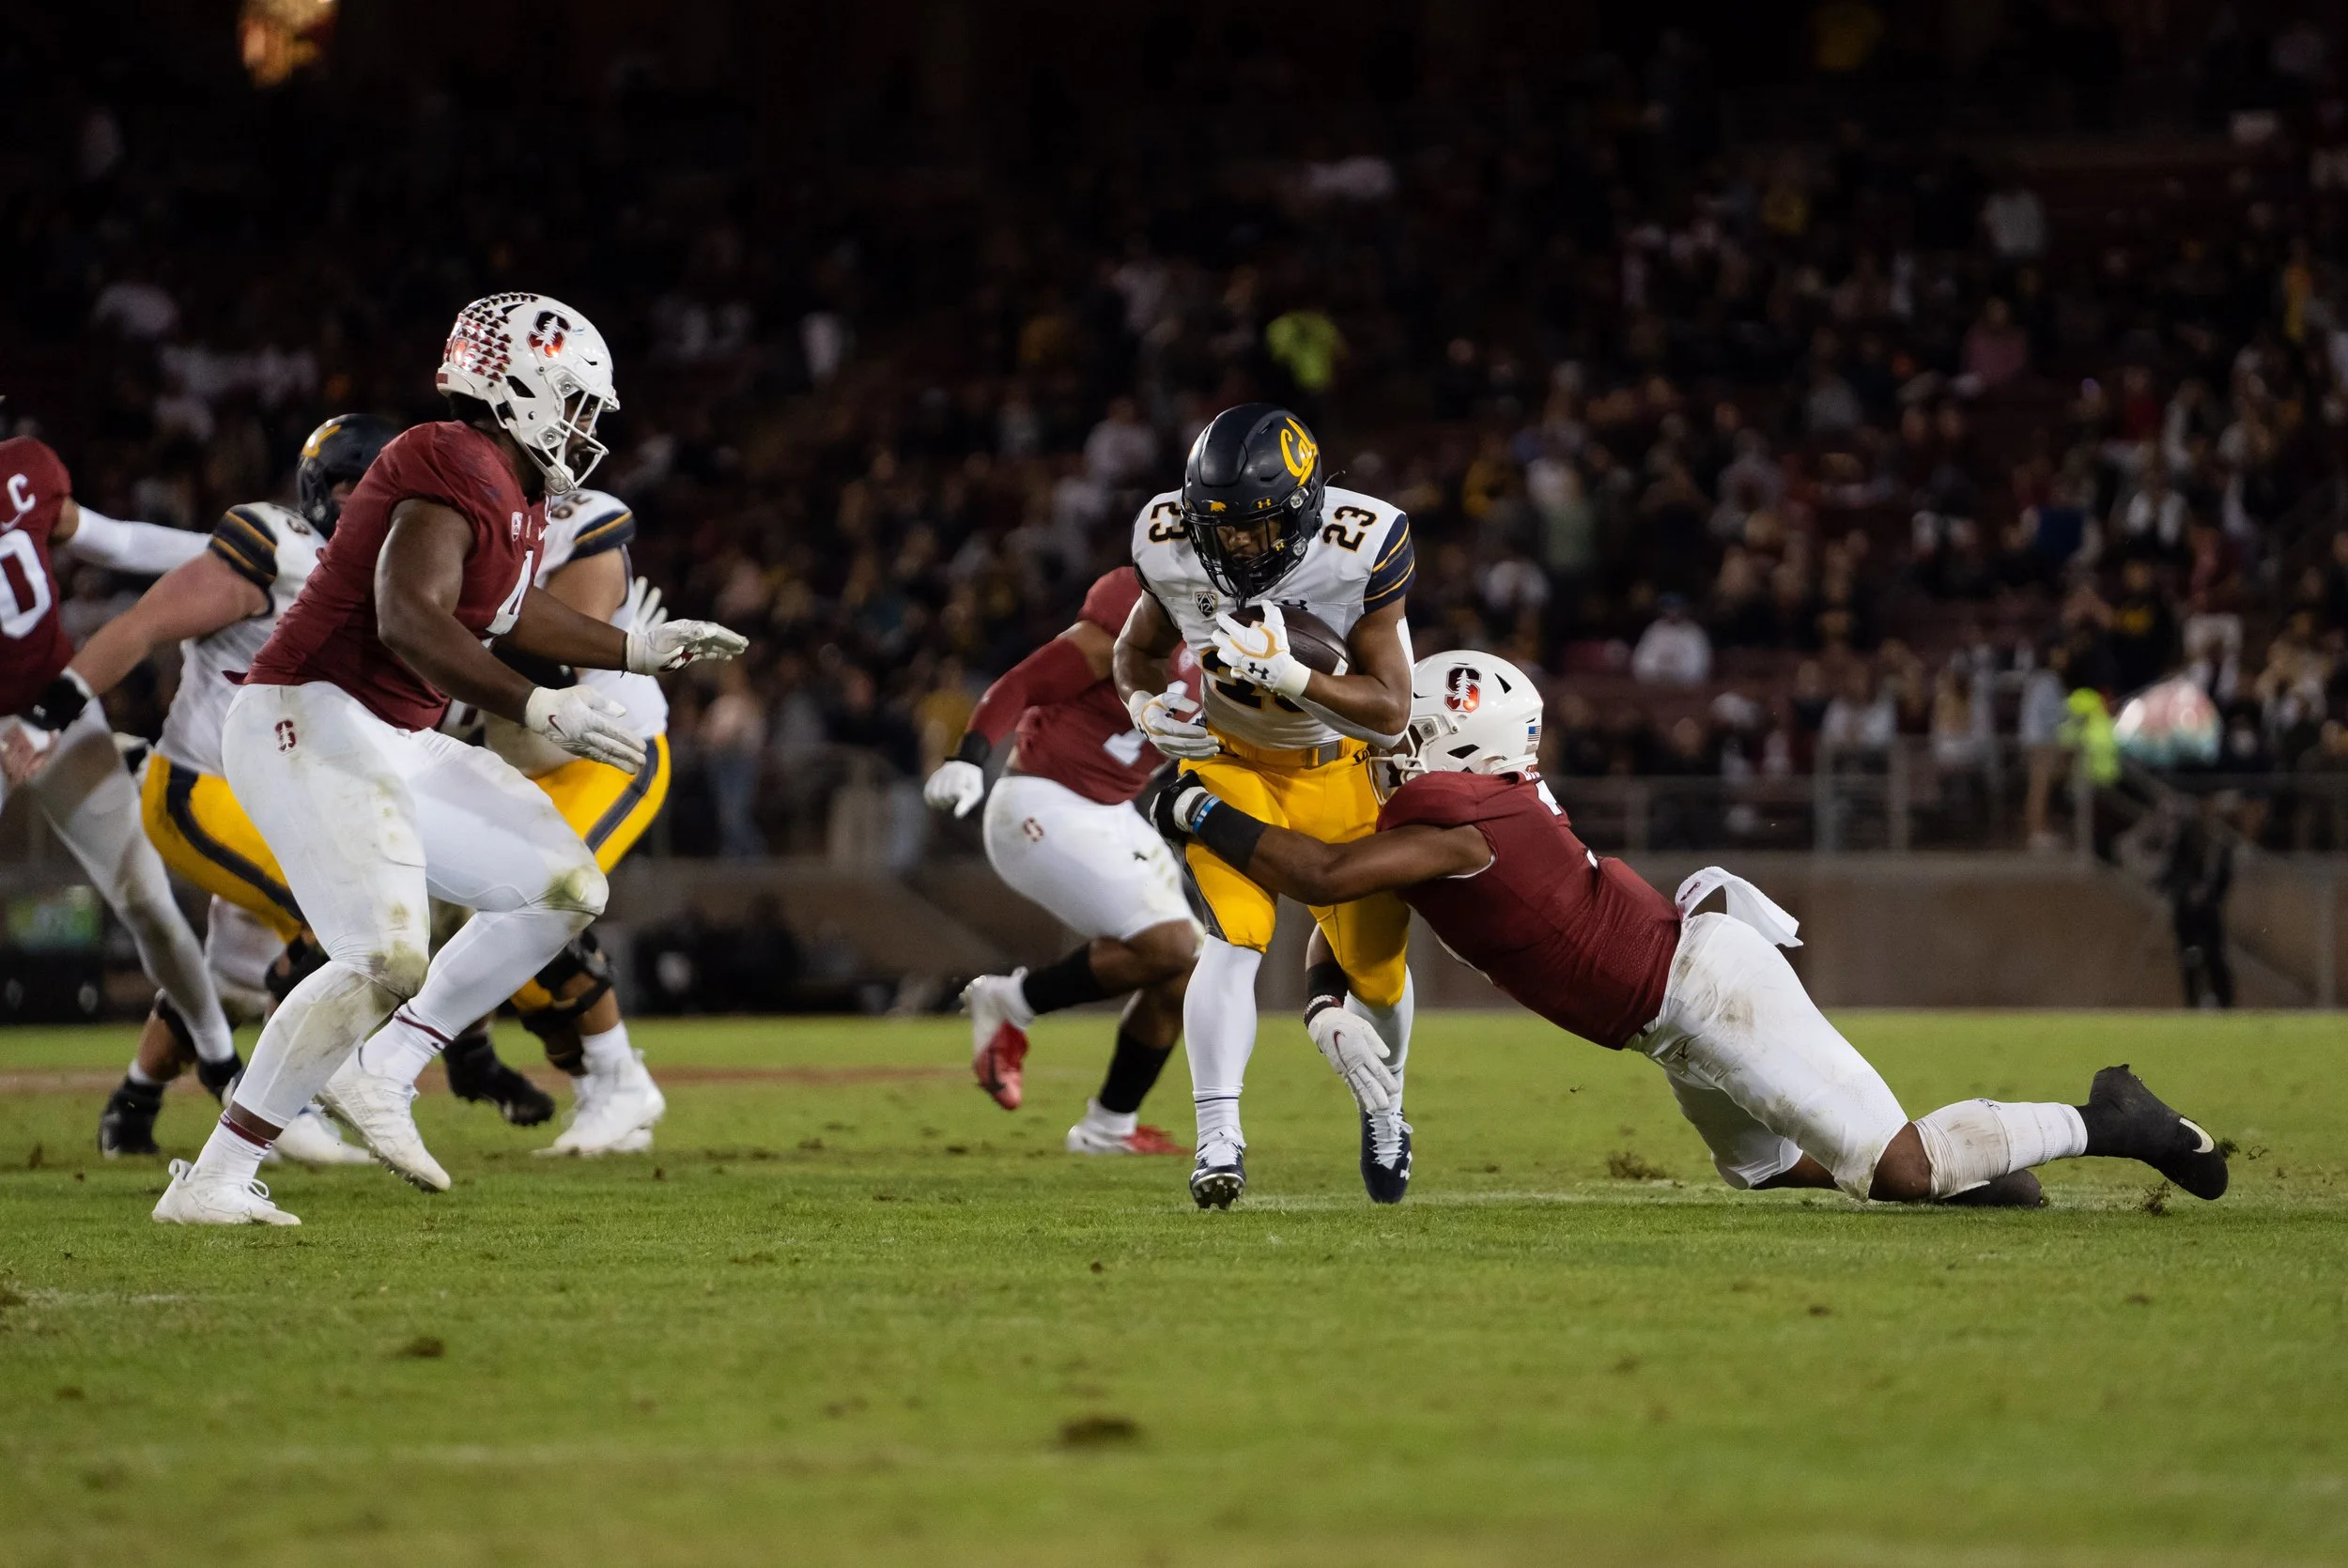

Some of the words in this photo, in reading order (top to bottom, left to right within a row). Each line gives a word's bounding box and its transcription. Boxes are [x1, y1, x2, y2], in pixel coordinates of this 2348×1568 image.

[1280, 417, 1318, 487] Cal
[7, 472, 36, 513] C
[1149, 500, 1189, 544] 23
[1322, 505, 1378, 553] 23
[1200, 603, 1213, 613] 12
